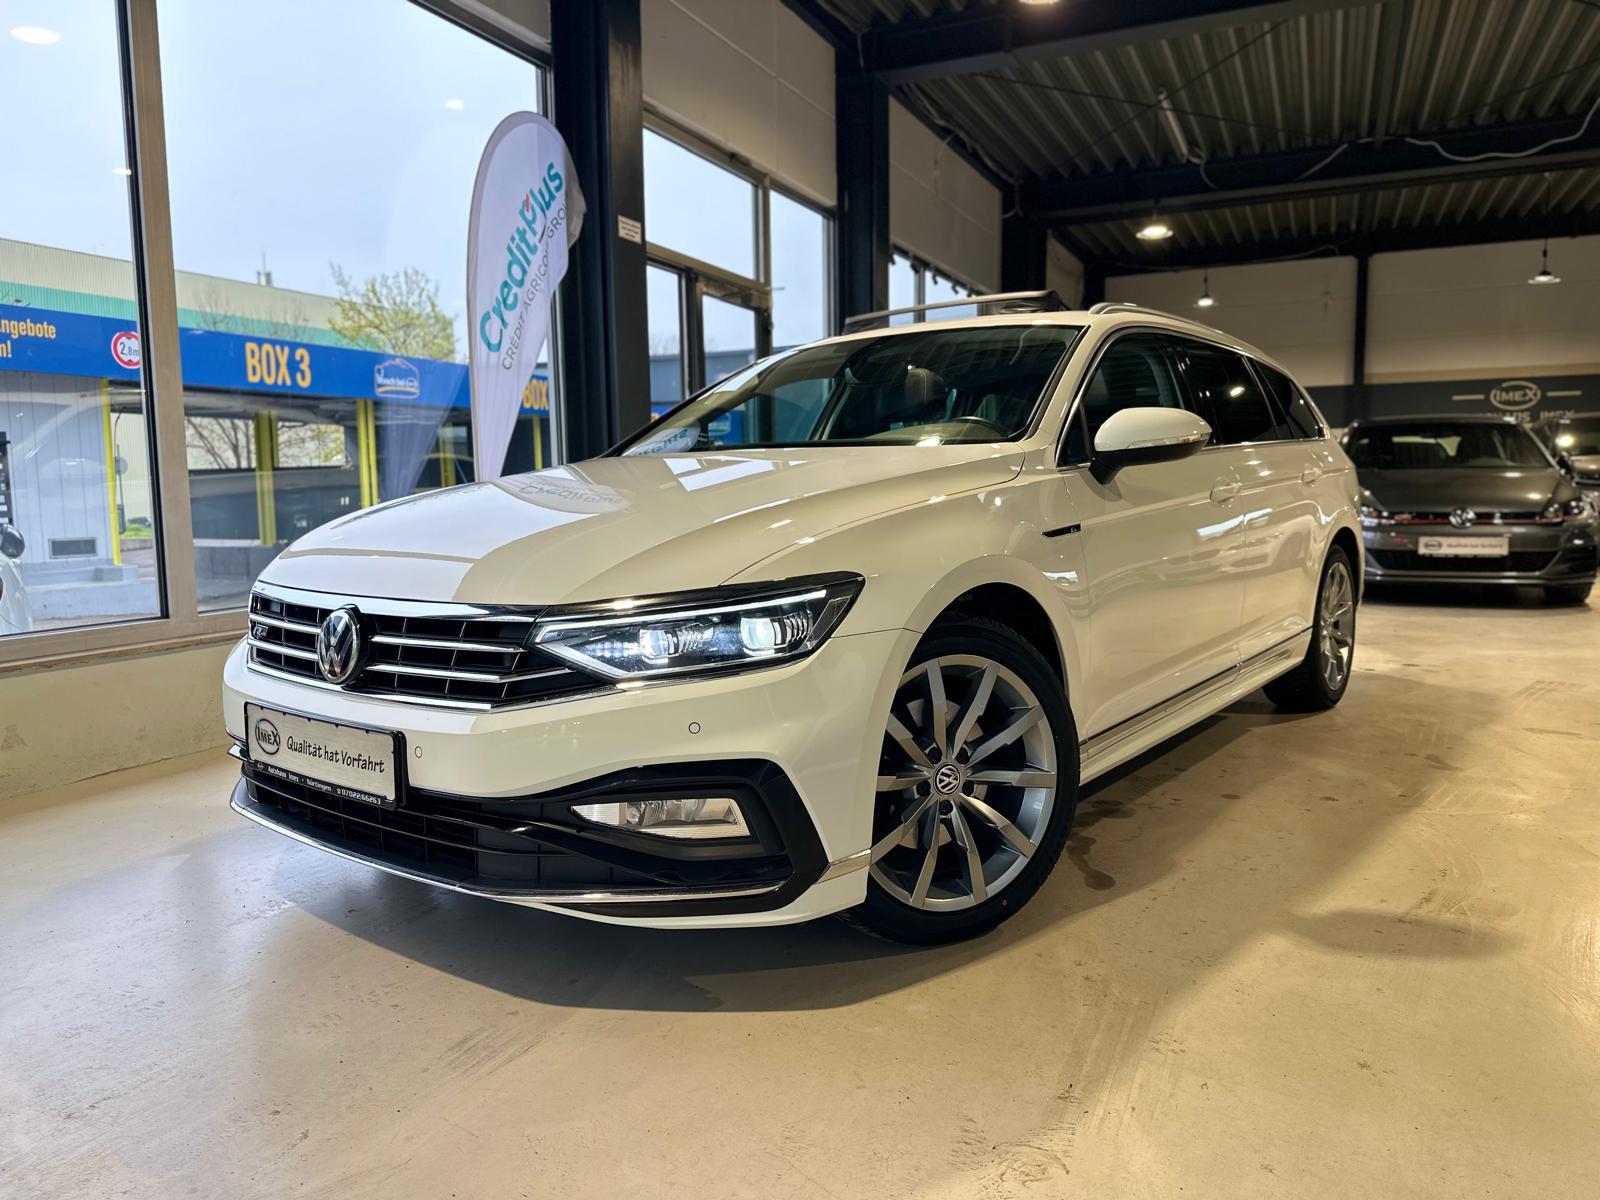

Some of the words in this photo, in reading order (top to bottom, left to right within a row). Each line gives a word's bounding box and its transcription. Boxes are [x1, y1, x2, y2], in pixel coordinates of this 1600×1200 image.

[546, 203, 567, 239] GRO
[0, 318, 56, 339] ngebote
[245, 341, 291, 386] BOX
[294, 347, 312, 388] 3
[1496, 388, 1537, 403] IMEX
[287, 736, 323, 758] Qualität
[324, 745, 340, 764] hat
[341, 750, 385, 773] Vorfahrt
